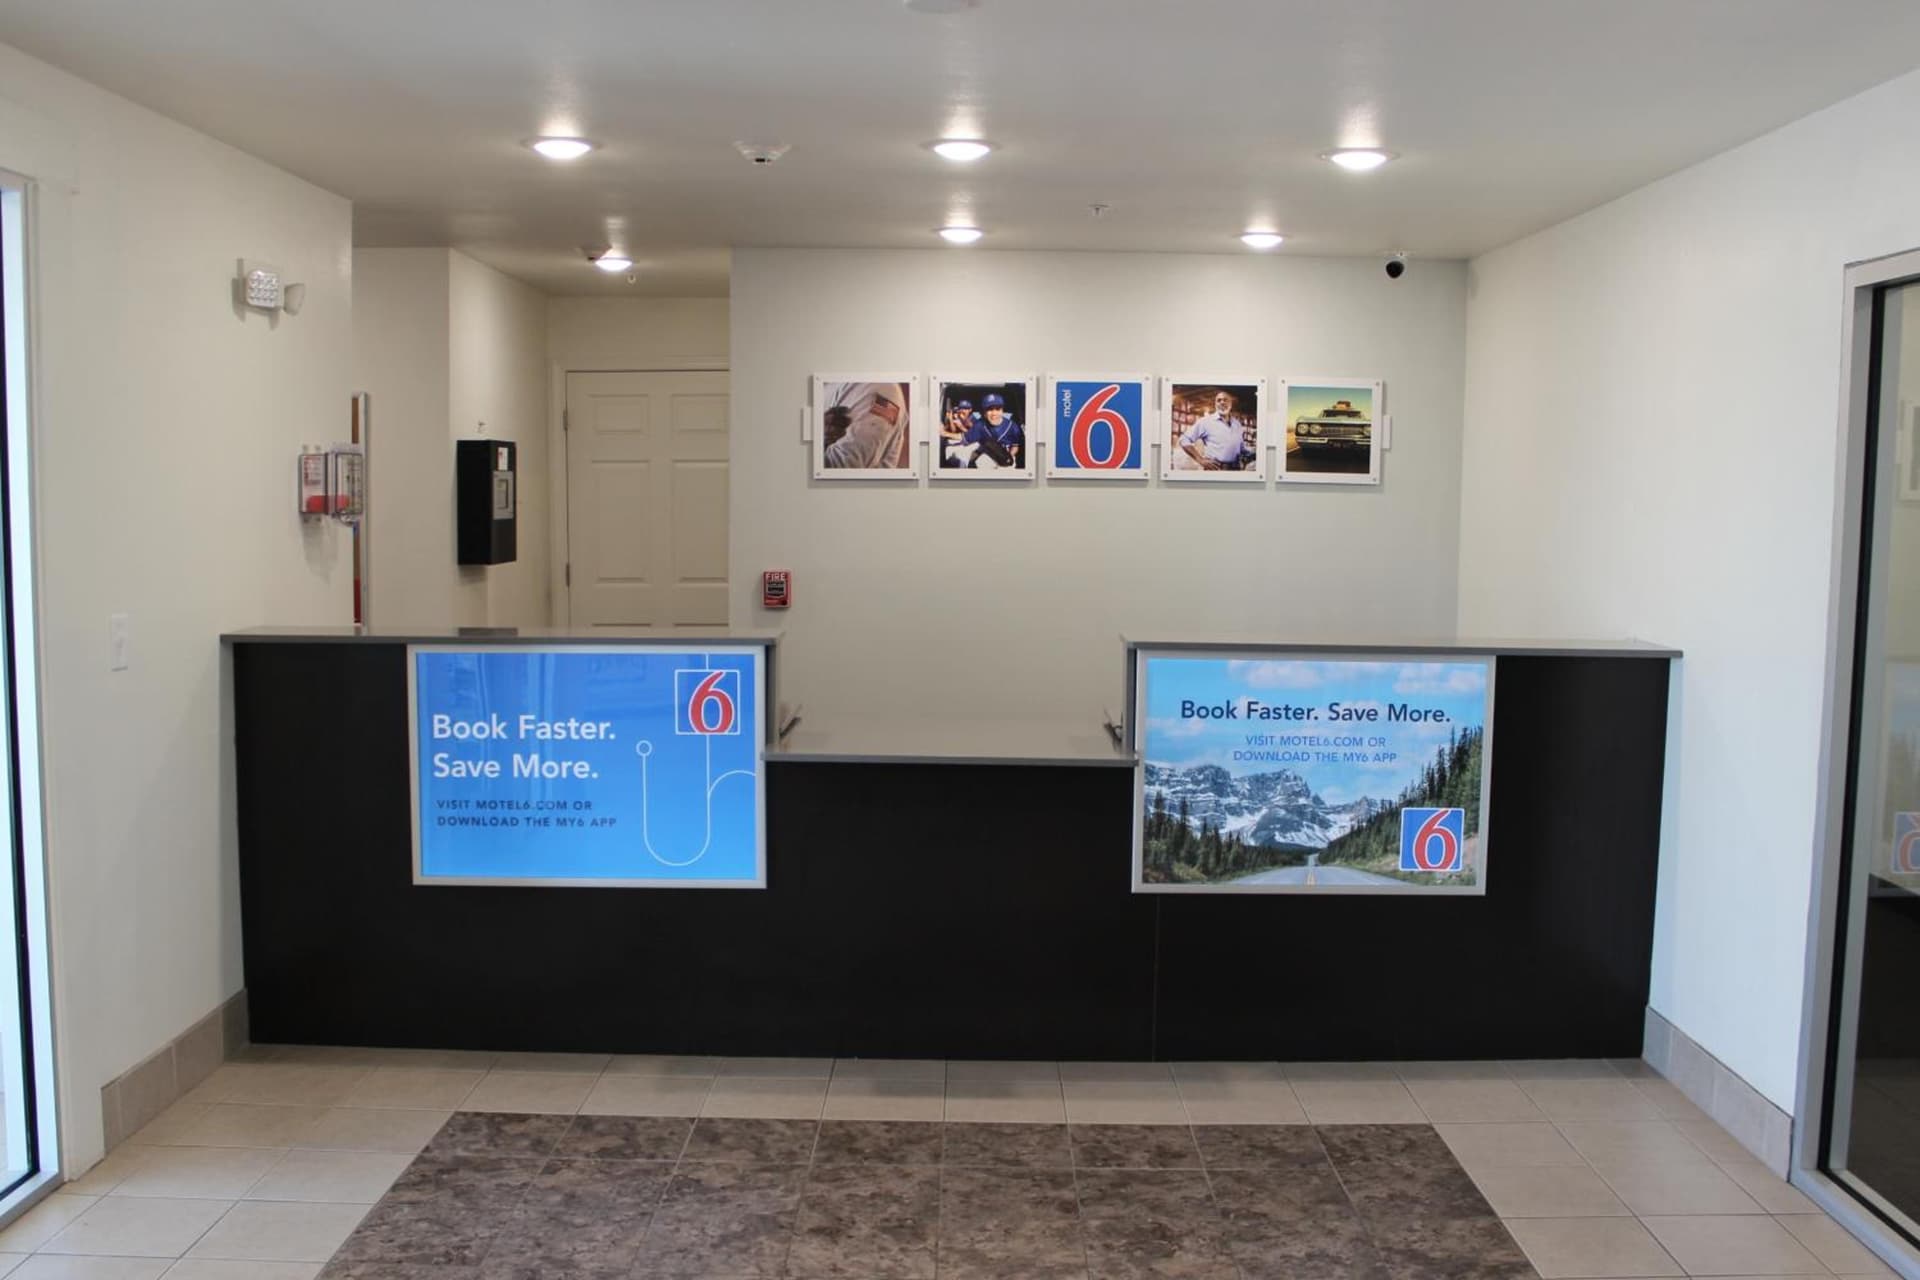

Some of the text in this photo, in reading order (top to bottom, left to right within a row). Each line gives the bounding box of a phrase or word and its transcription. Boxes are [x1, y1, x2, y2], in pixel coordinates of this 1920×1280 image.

[1062, 389, 1072, 418] motel
[1070, 384, 1131, 469] 6
[688, 669, 735, 735] 6
[1181, 699, 1451, 723] Book Faster. Save More.
[432, 713, 617, 741] Book Faster.
[1245, 735, 1277, 747] VISIT
[1367, 736, 1387, 748] OR
[432, 753, 600, 780] Save More.
[1233, 751, 1398, 764] DOWNLOAD THE MY6 APP
[436, 800, 471, 811] VISIT
[572, 801, 593, 811] OR
[436, 816, 618, 828] DOWNLOAD THE MY6 APP
[1412, 808, 1457, 871] 6
